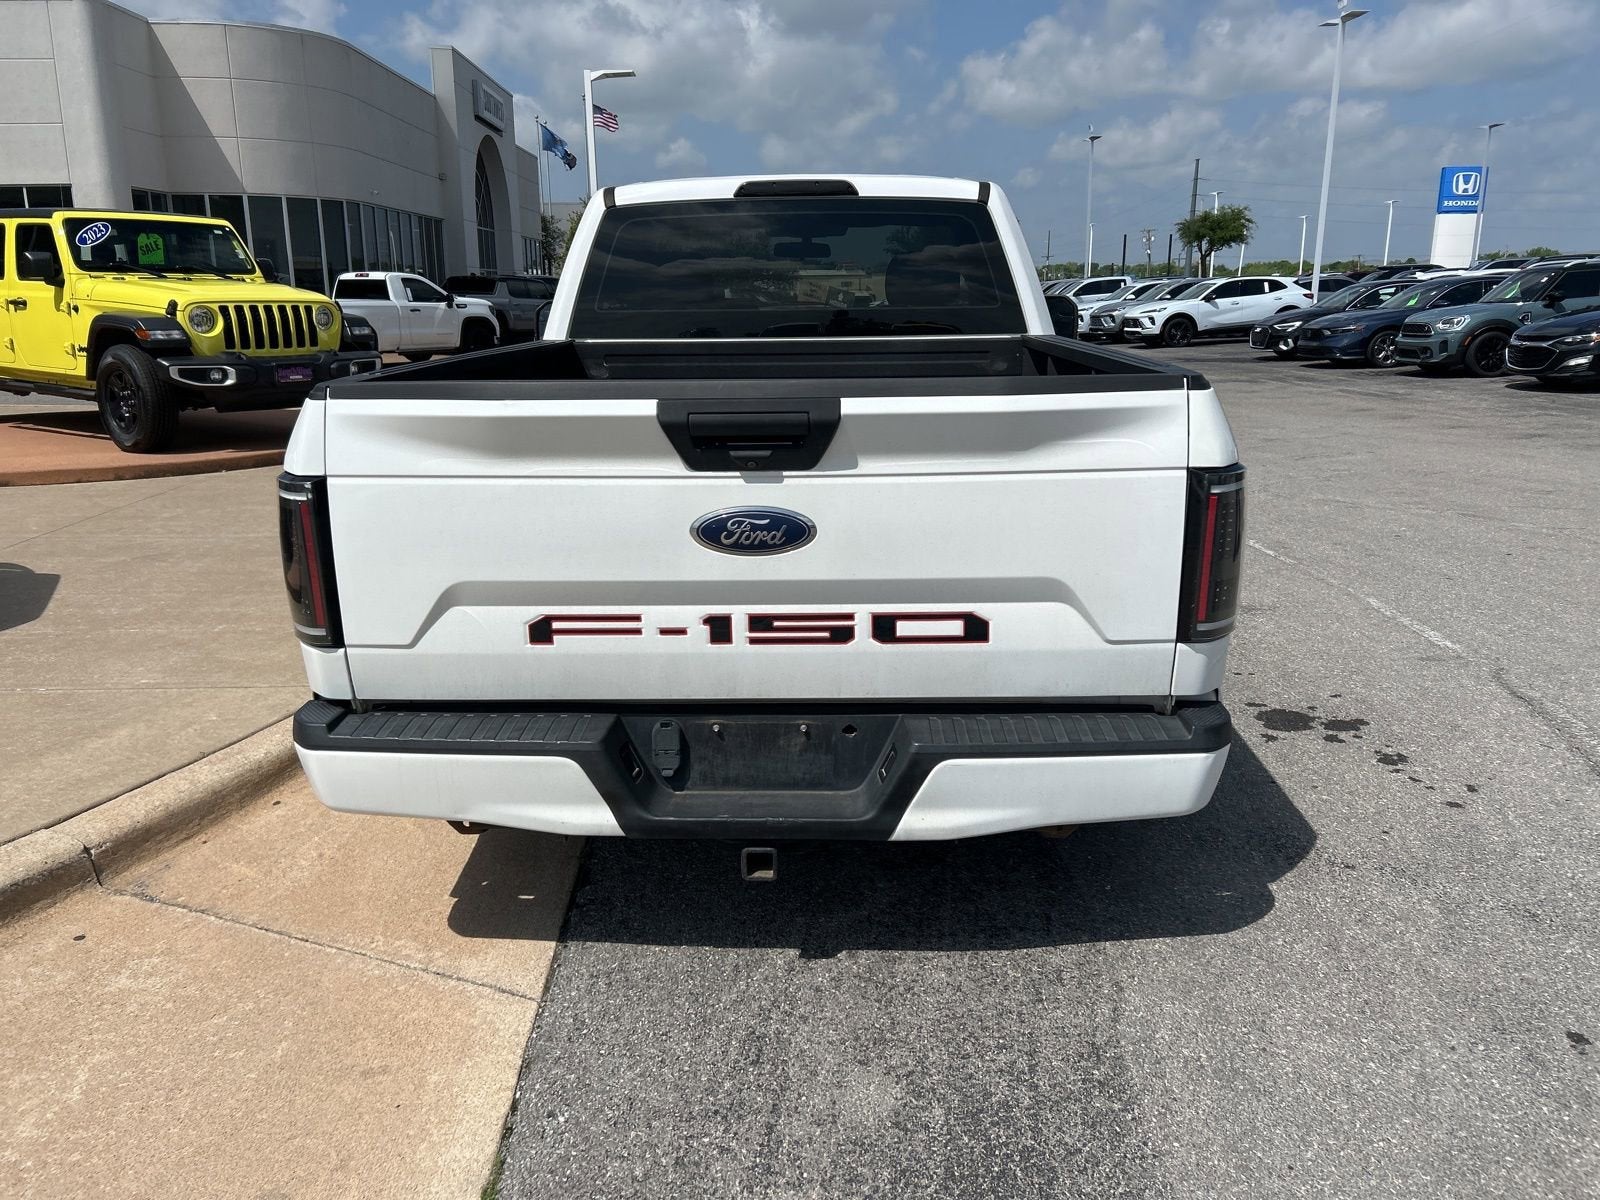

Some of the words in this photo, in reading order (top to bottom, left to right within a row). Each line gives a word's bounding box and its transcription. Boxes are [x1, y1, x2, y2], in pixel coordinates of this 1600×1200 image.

[82, 224, 106, 244] 2023
[140, 240, 161, 256] SALE
[720, 517, 788, 545] Ford
[526, 611, 991, 645] F-150
